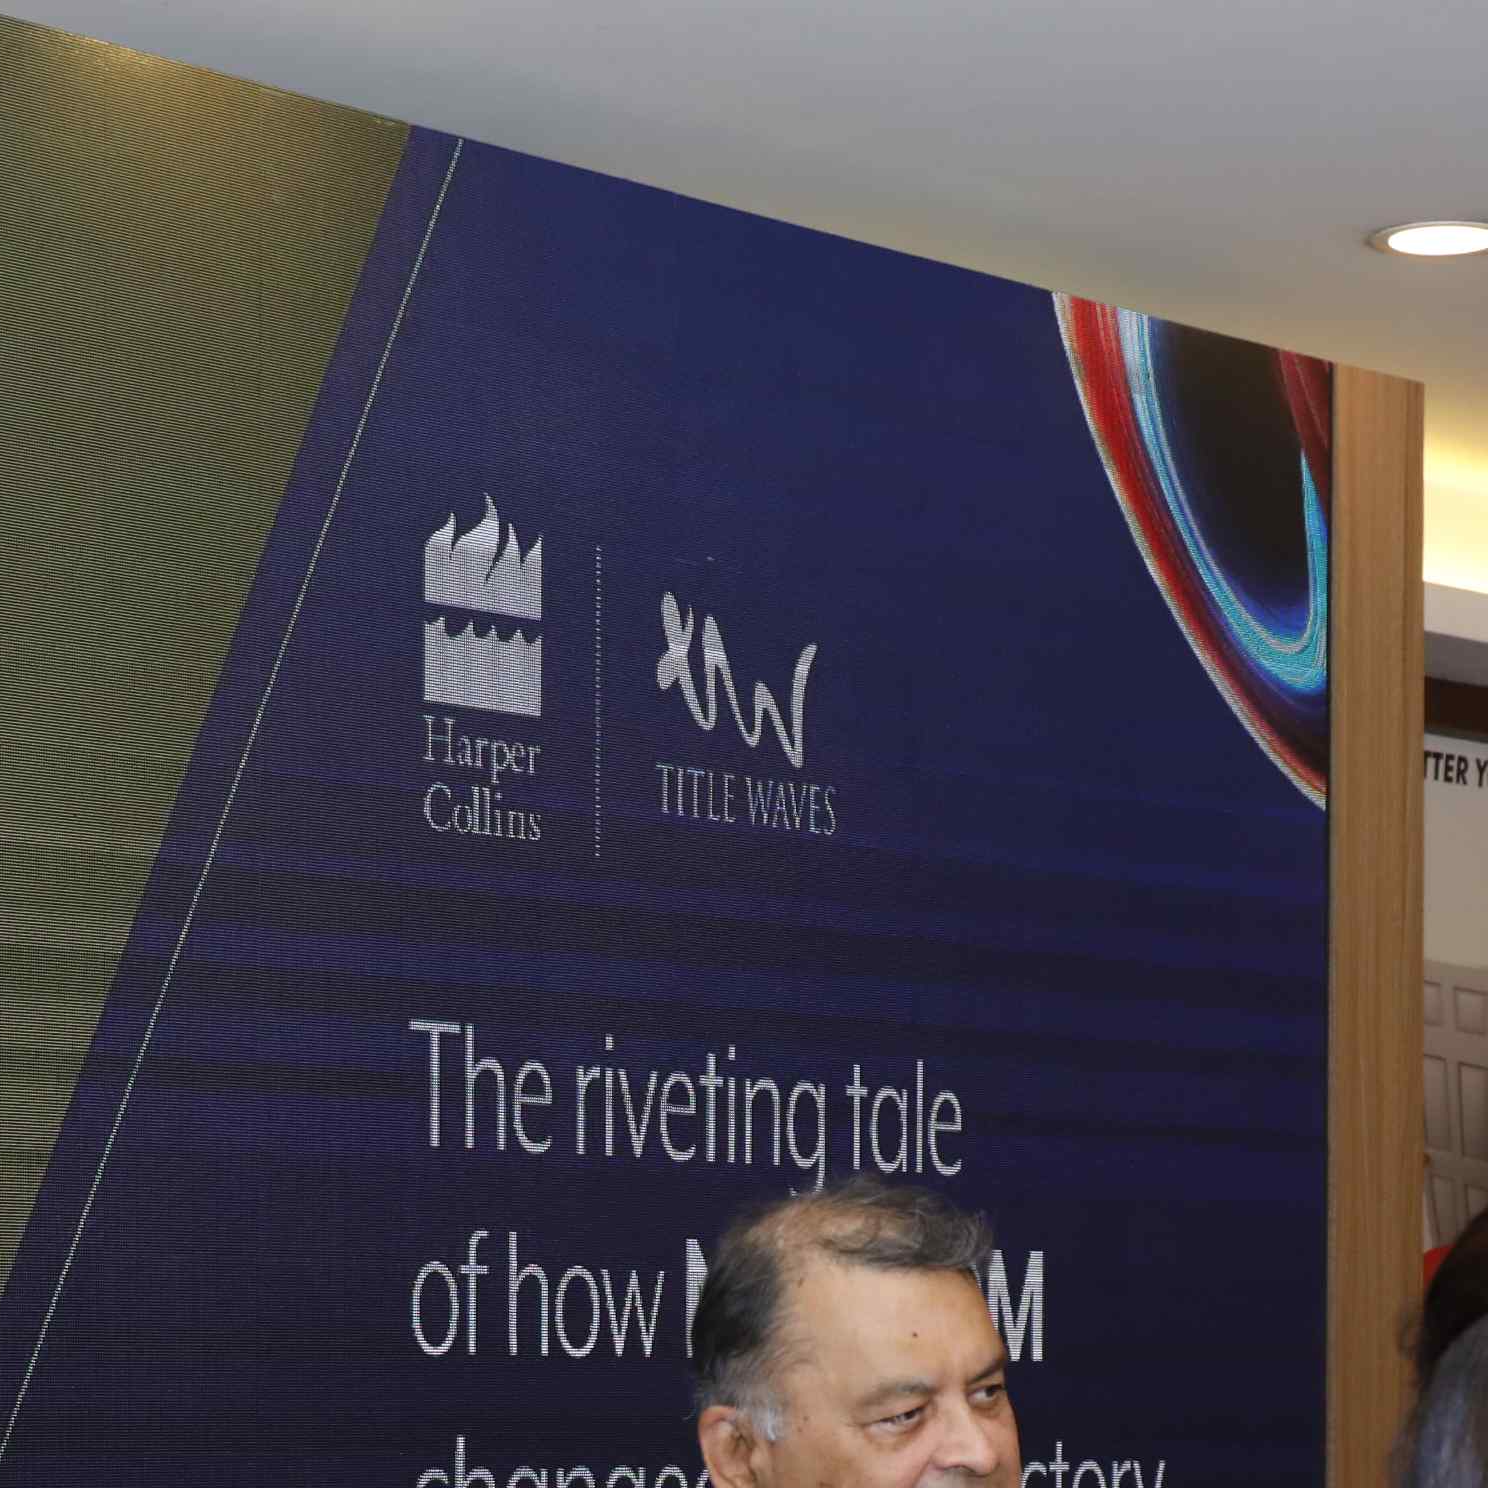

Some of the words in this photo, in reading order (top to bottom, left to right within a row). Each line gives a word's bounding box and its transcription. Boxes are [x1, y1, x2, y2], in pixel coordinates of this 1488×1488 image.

[423, 715, 542, 785] Harper
[1424, 750, 1468, 786] TTER
[423, 782, 542, 841] Collins
[656, 761, 737, 825] TITLE
[744, 775, 838, 837] WAVES
[409, 1018, 555, 1155] The
[574, 1033, 828, 1198] riveting
[846, 1058, 965, 1177] tale
[410, 1229, 490, 1358] of
[508, 1230, 668, 1359] how
